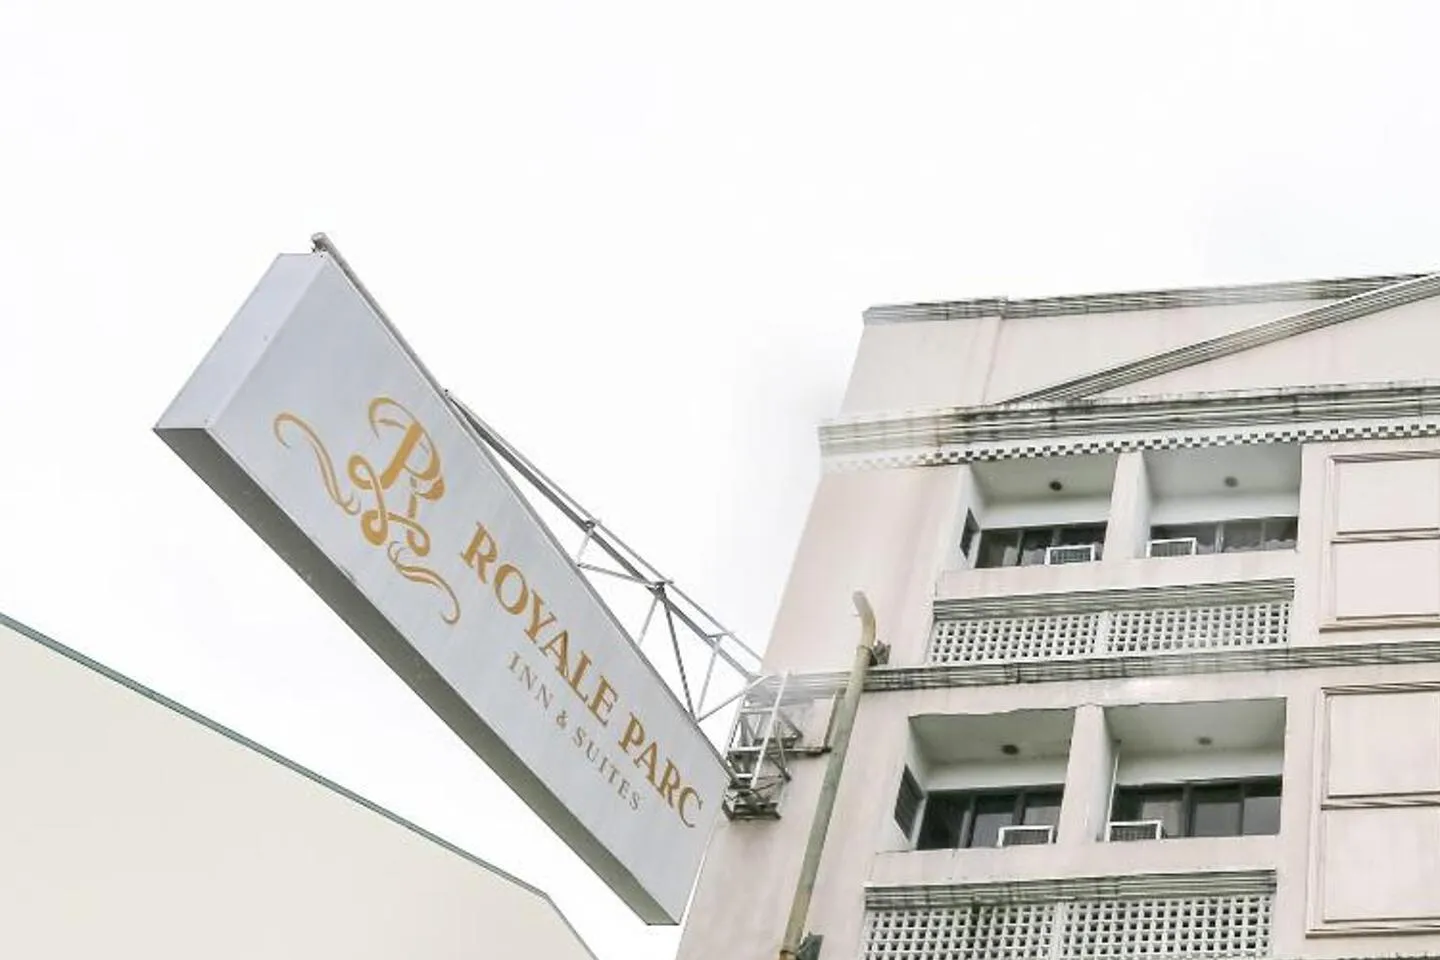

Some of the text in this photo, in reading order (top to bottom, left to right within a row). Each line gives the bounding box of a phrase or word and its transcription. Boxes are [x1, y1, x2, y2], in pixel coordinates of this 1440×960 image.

[461, 521, 703, 828] ROYALE PARC
[507, 651, 643, 812] INN & SUITES
